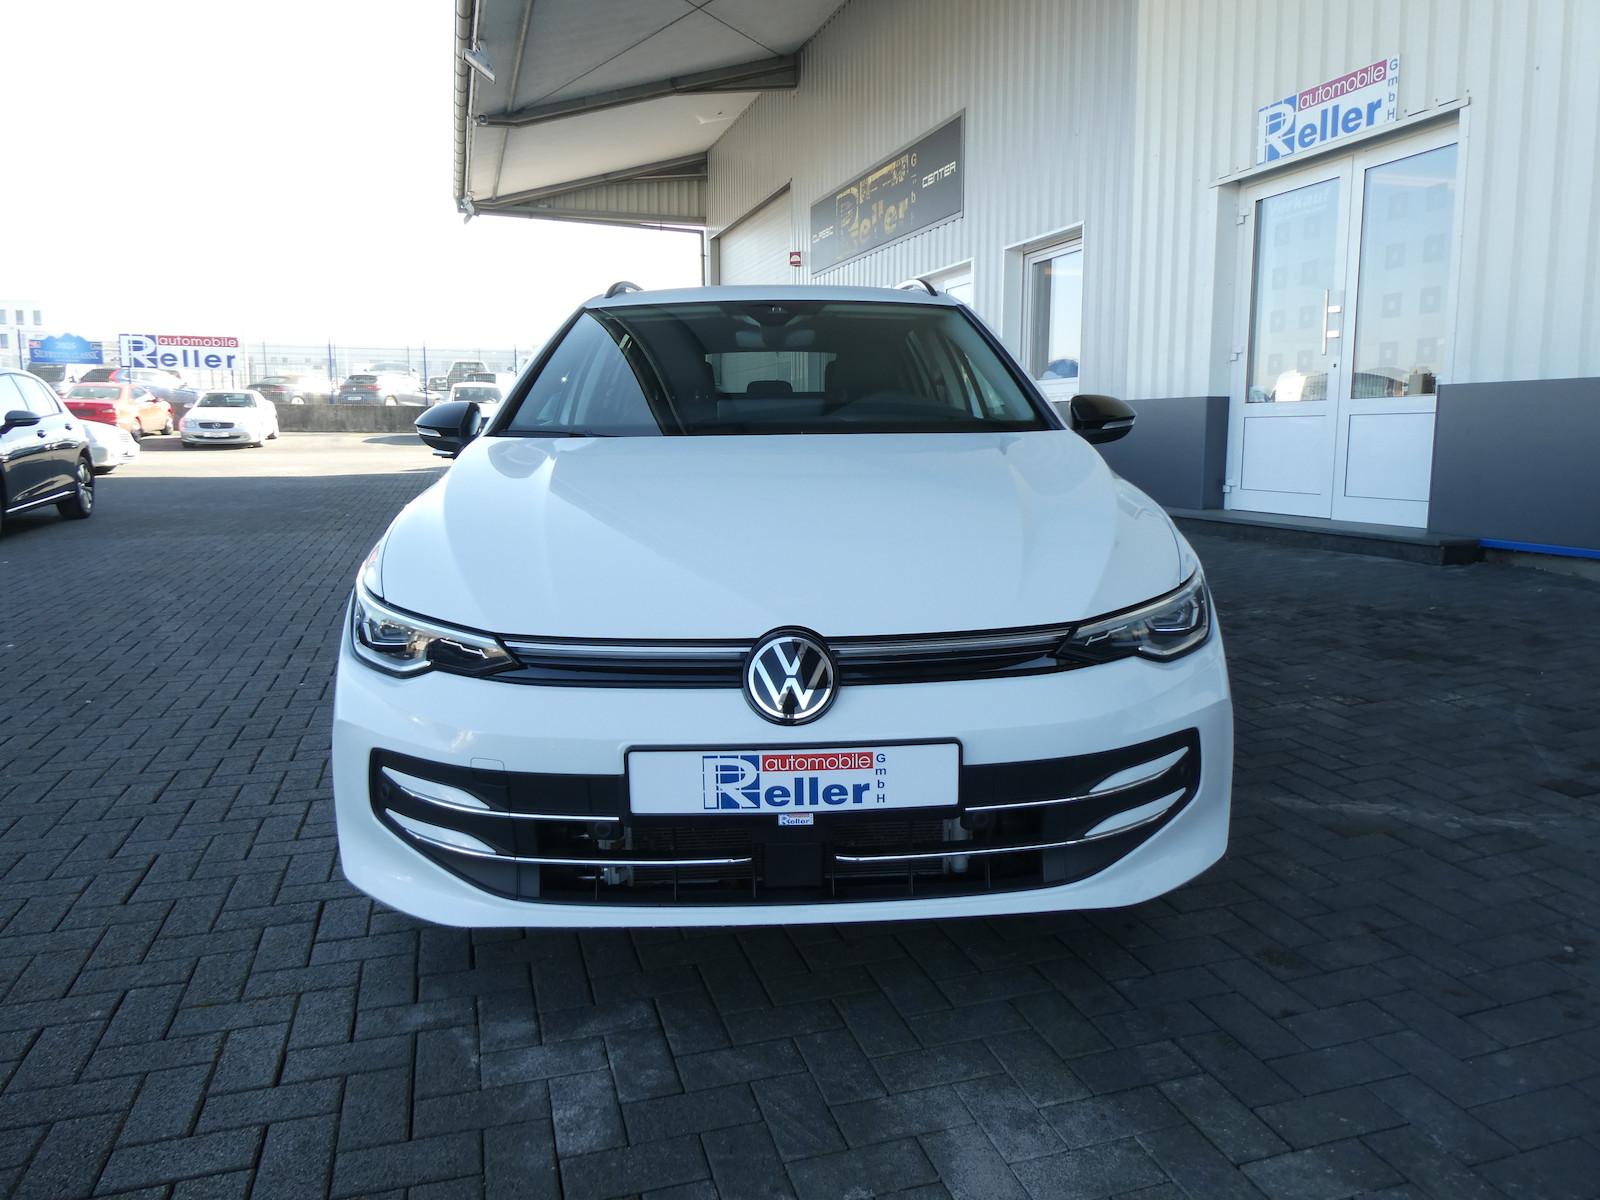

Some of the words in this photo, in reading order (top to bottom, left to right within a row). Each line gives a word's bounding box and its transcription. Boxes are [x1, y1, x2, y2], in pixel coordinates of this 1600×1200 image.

[1300, 64, 1385, 110] automobile
[1257, 98, 1382, 164] Reller
[922, 161, 956, 188] CENTER
[120, 334, 235, 368] Reller
[159, 336, 237, 346] automobile
[703, 756, 870, 809] Reller
[765, 755, 871, 771] automobile
[876, 753, 887, 803] GmbH
